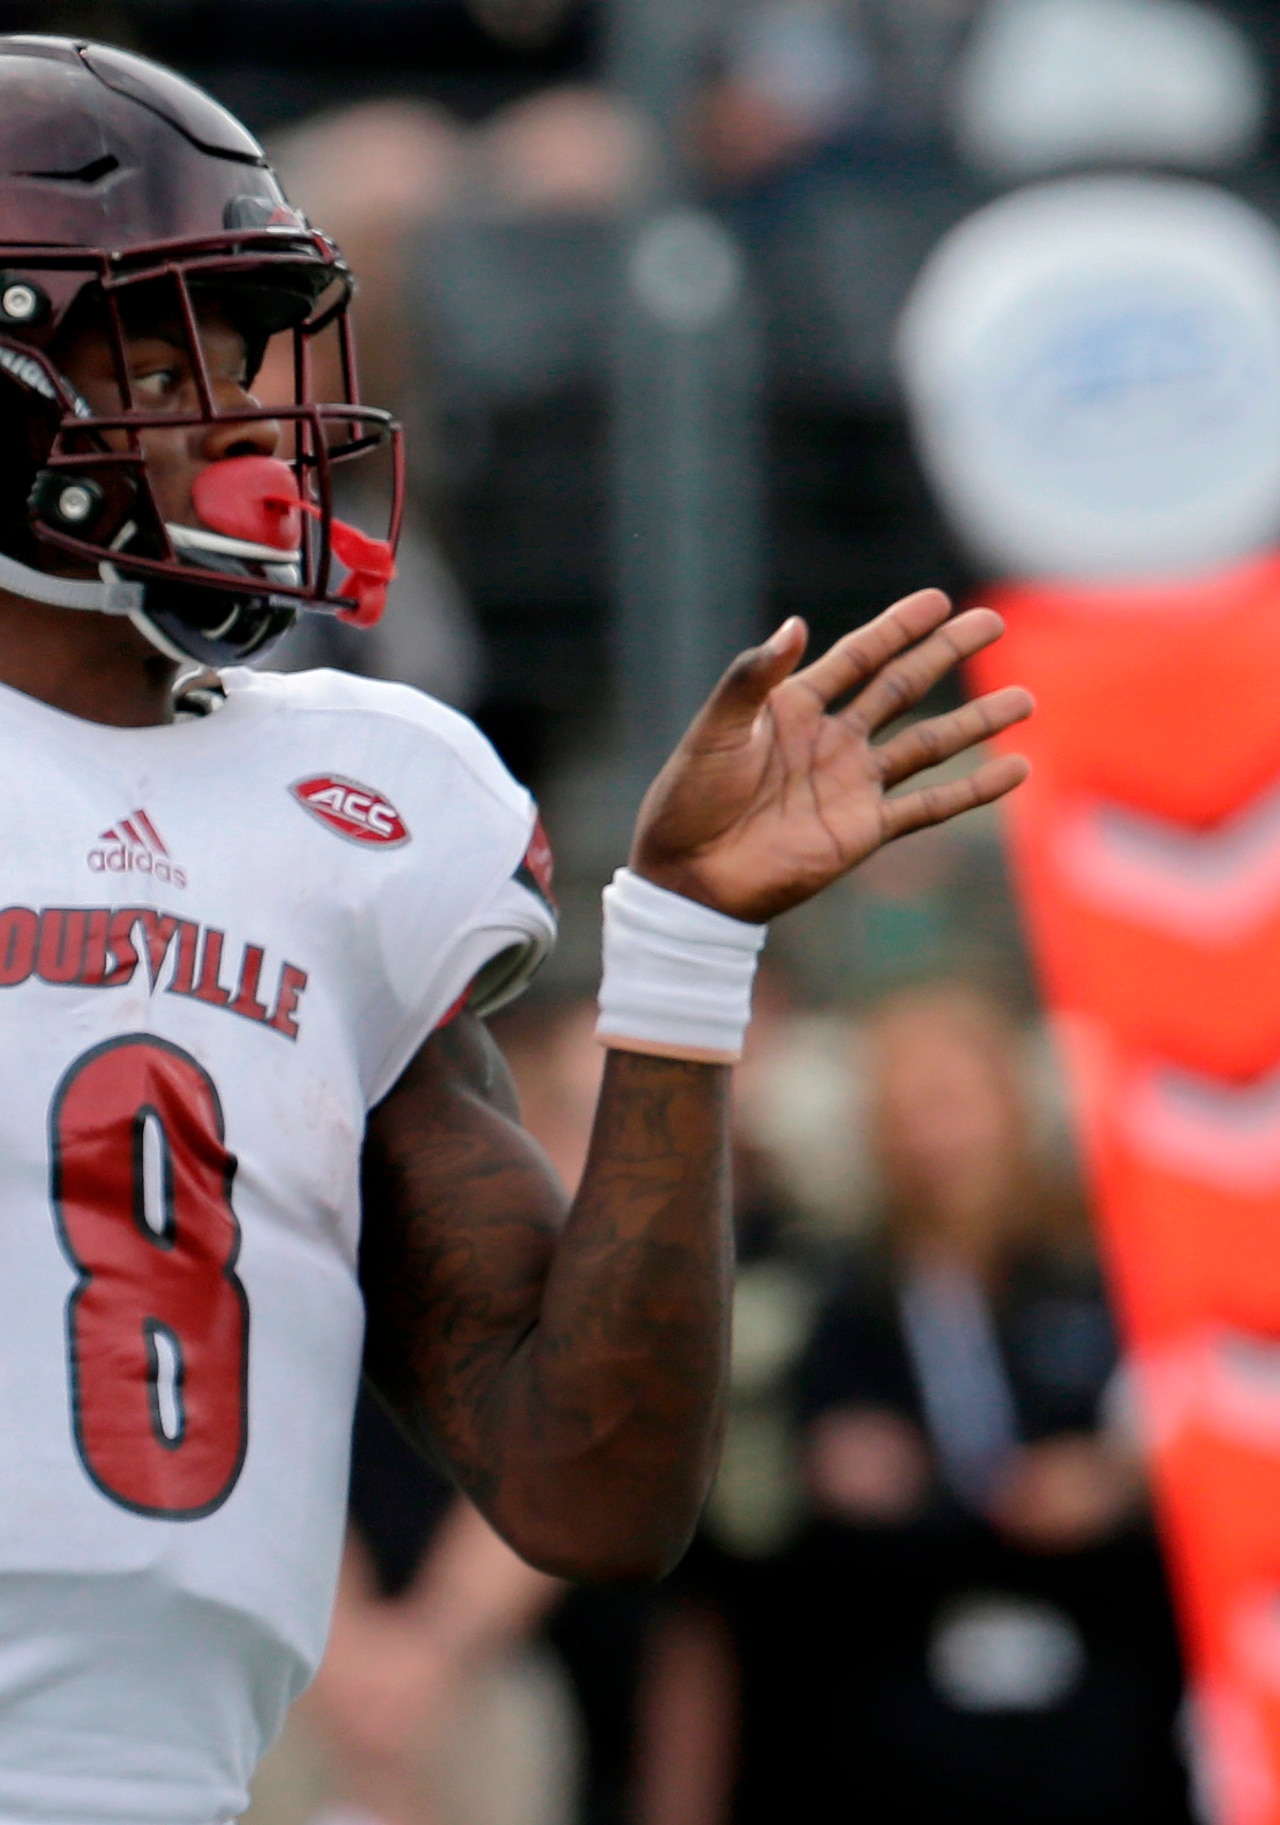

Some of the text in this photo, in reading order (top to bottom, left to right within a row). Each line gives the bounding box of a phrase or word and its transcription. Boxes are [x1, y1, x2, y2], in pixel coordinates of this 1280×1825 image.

[306, 784, 398, 834] ACC
[87, 845, 187, 890] adidas
[47, 1032, 249, 1521] 8
